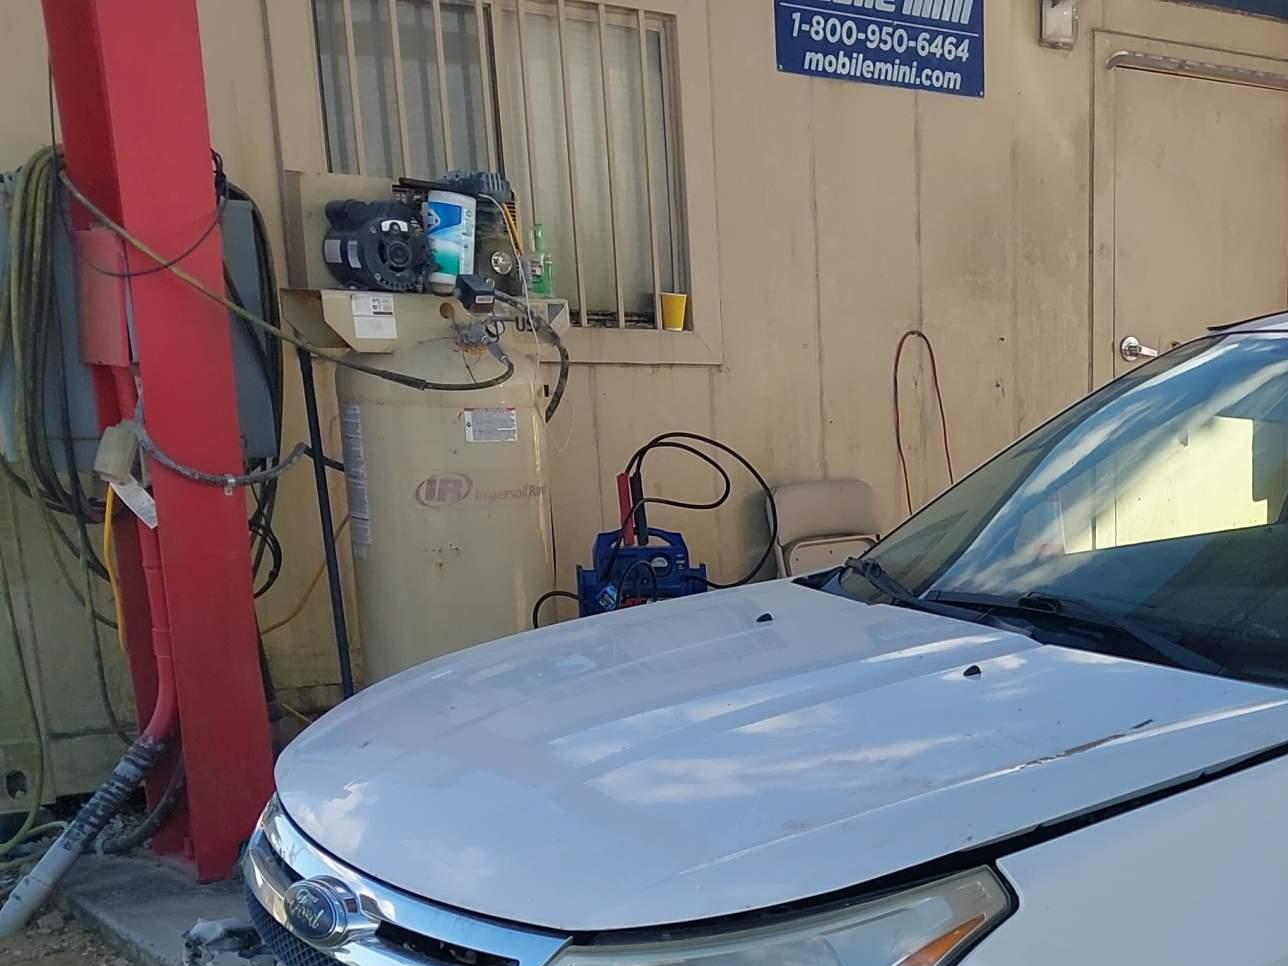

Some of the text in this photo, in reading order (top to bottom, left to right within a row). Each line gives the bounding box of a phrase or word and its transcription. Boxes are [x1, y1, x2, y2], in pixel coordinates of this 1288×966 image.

[791, 12, 969, 62] 1-800-950-6464
[803, 51, 961, 89] mobilemini.com
[290, 888, 324, 929] Ford
